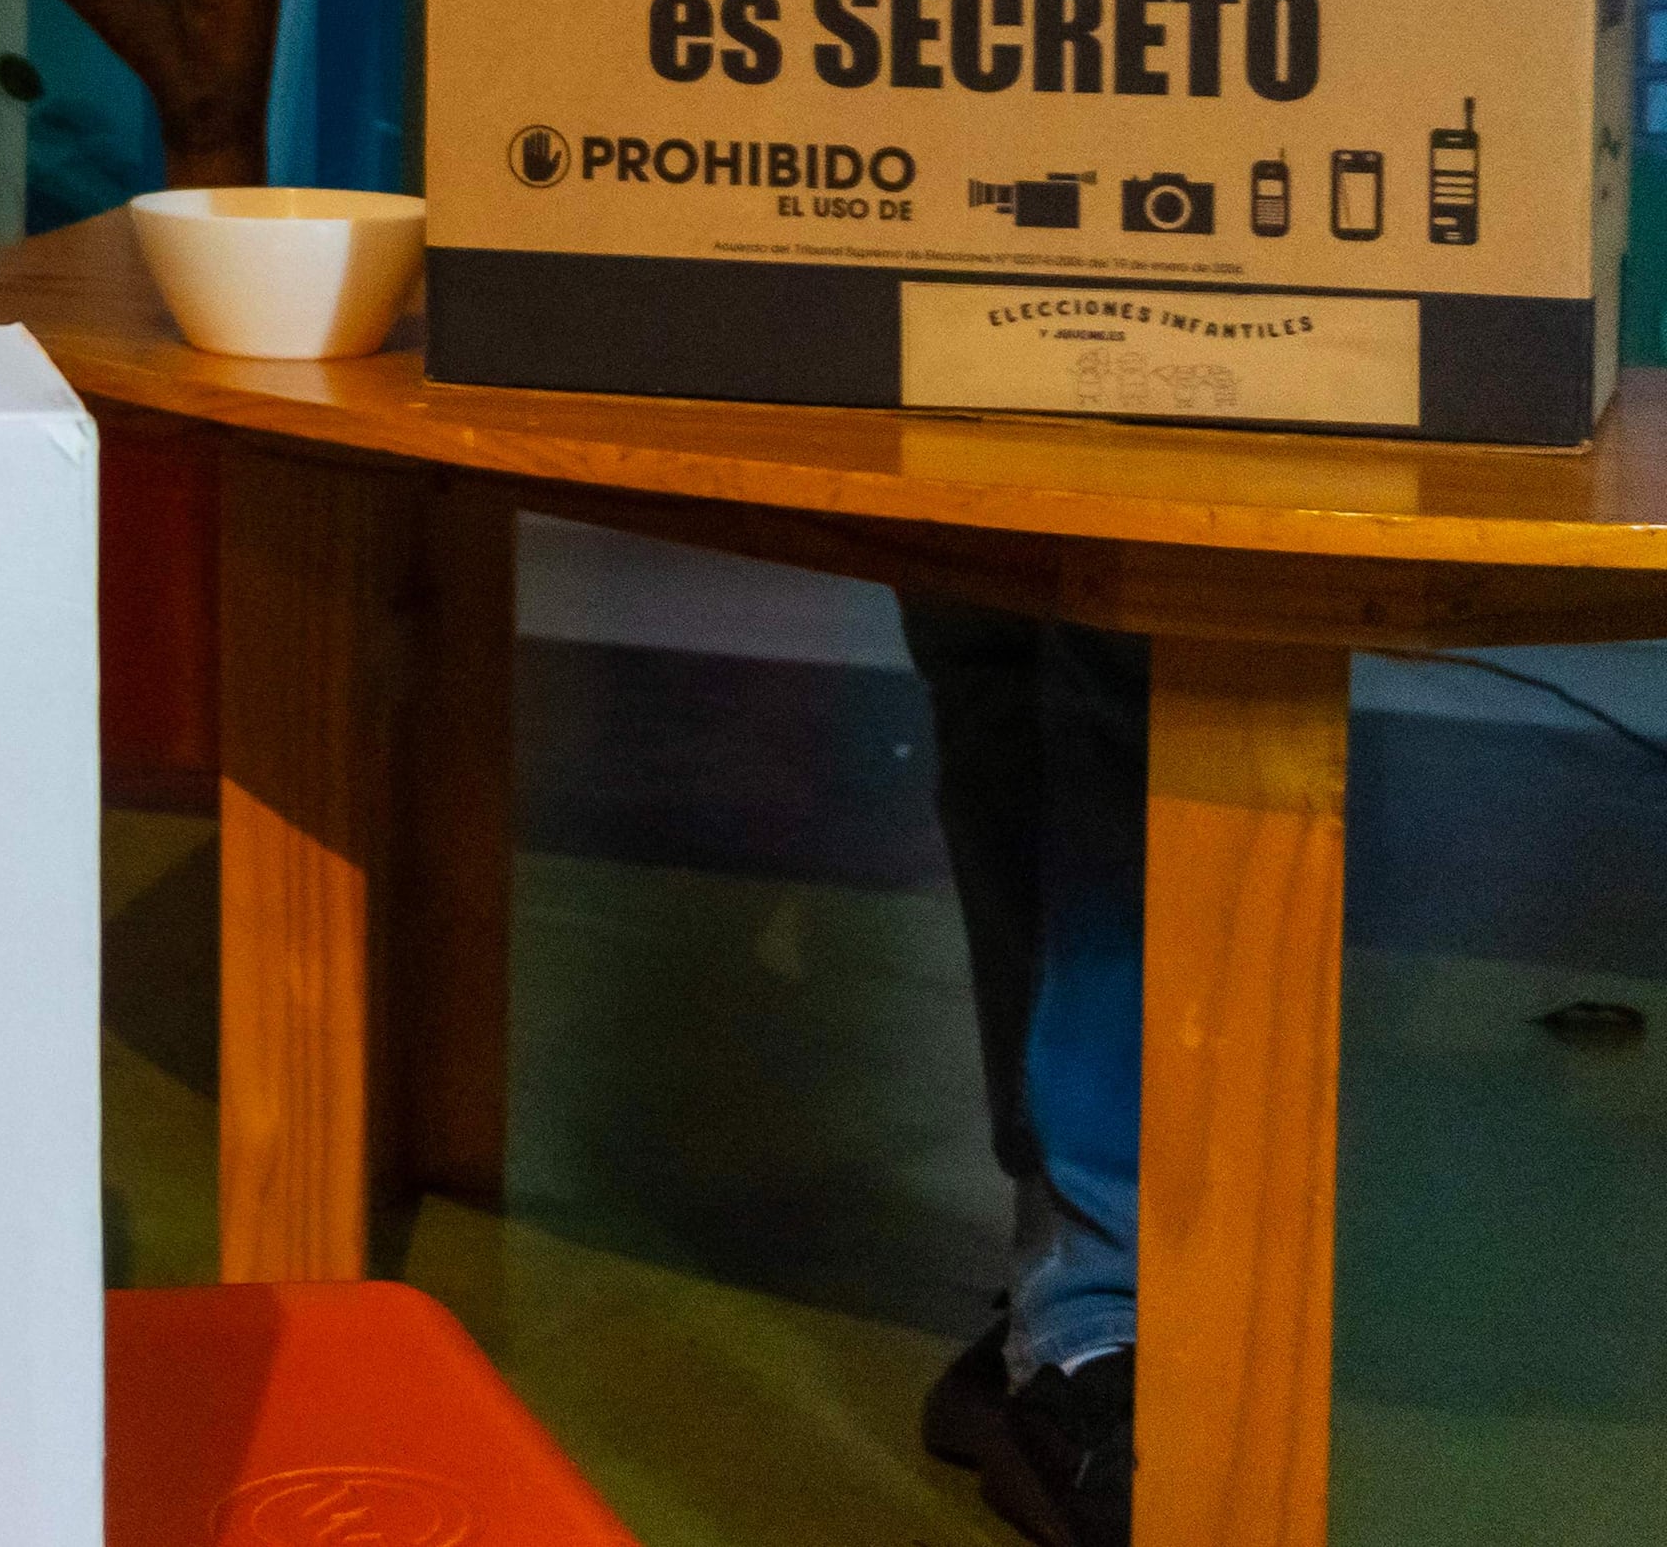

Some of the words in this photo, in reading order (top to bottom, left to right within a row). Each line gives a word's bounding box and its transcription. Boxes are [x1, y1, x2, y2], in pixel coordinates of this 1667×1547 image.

[582, 136, 916, 192] PROHIBIDO
[777, 195, 805, 217] EL
[813, 196, 869, 221] USO
[879, 198, 913, 222] DE
[988, 300, 1151, 326] ELECCIONES
[1161, 311, 1314, 339] INFANTILES
